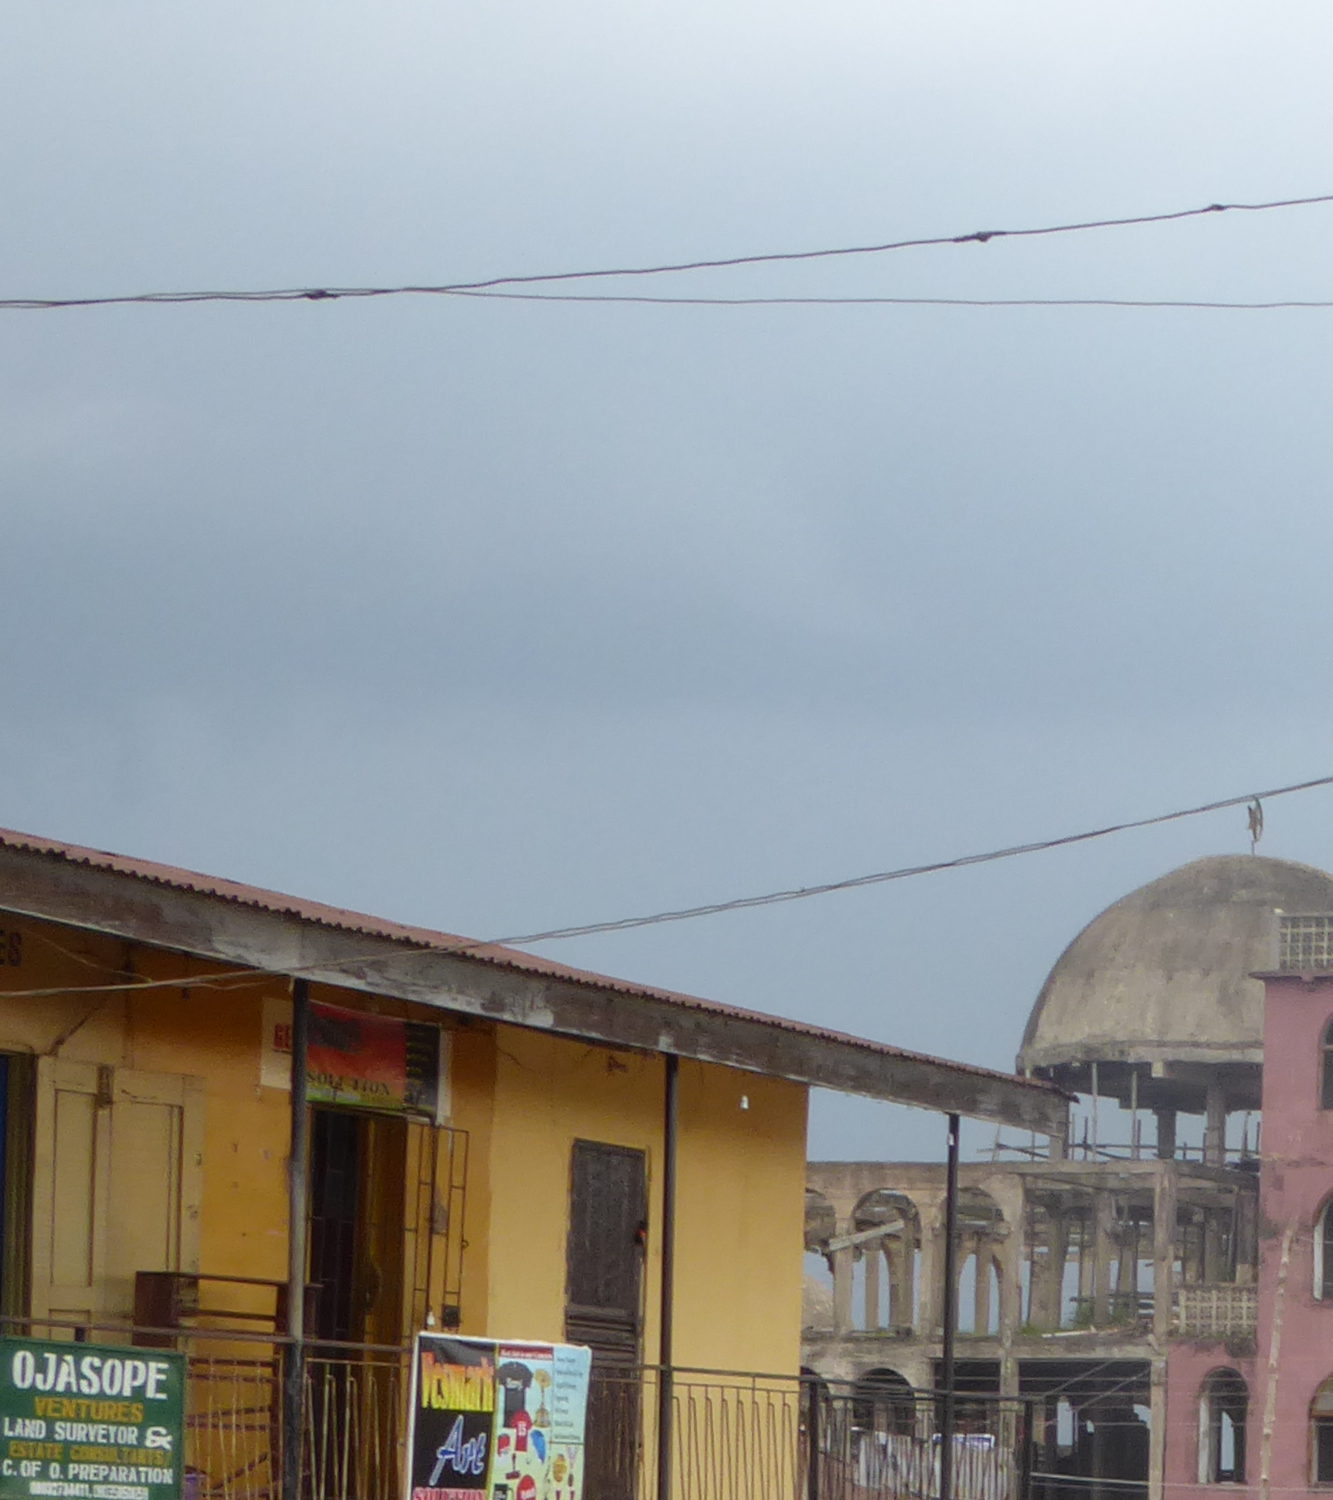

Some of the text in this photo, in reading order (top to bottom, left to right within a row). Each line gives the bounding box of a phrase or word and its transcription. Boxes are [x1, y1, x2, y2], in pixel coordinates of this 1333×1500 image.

[12, 1351, 169, 1399] OJASOPE
[35, 1397, 144, 1423] VENTURES
[4, 1417, 173, 1450] LAND SURVEYOR &
[9, 1440, 63, 1459] ESTATE
[429, 1414, 486, 1486] Art
[20, 1460, 41, 1478] OF
[68, 1463, 173, 1484] PREPARATION
